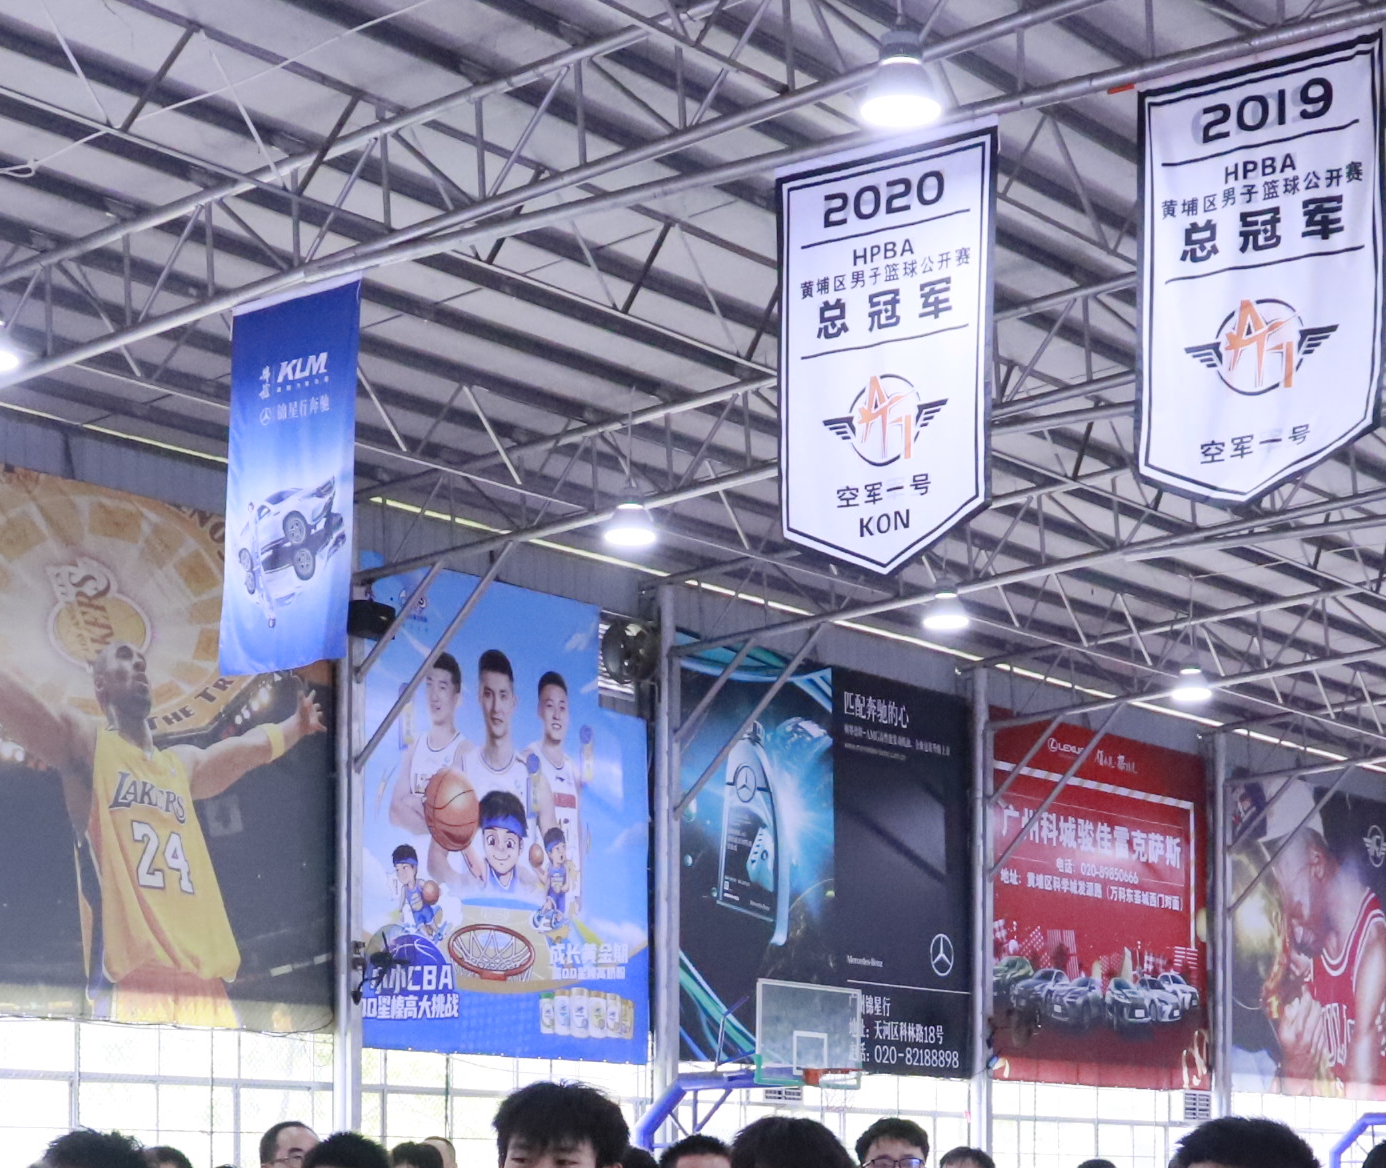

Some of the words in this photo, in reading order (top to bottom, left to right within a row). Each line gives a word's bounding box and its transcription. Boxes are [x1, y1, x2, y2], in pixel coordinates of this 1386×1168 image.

[1201, 77, 1334, 144] 2019
[1161, 161, 1364, 219] 黄埔区男子篮球公开赛
[1224, 152, 1298, 185] HPBA
[823, 169, 946, 229] 2020
[852, 238, 915, 267] HPBA
[1179, 194, 1346, 264] 总冠军
[800, 246, 972, 300] 黄埔区男子篮球公开赛
[816, 276, 954, 340] 总冠军
[277, 352, 328, 383] KLM
[1199, 424, 1312, 464] 空军一号
[836, 473, 932, 509] 空军一号
[859, 508, 911, 538] KON
[843, 691, 910, 729] 匹配奔驰的心
[1058, 743, 1084, 755] LEXU
[109, 770, 187, 824] LAKERS
[132, 820, 195, 896] 24
